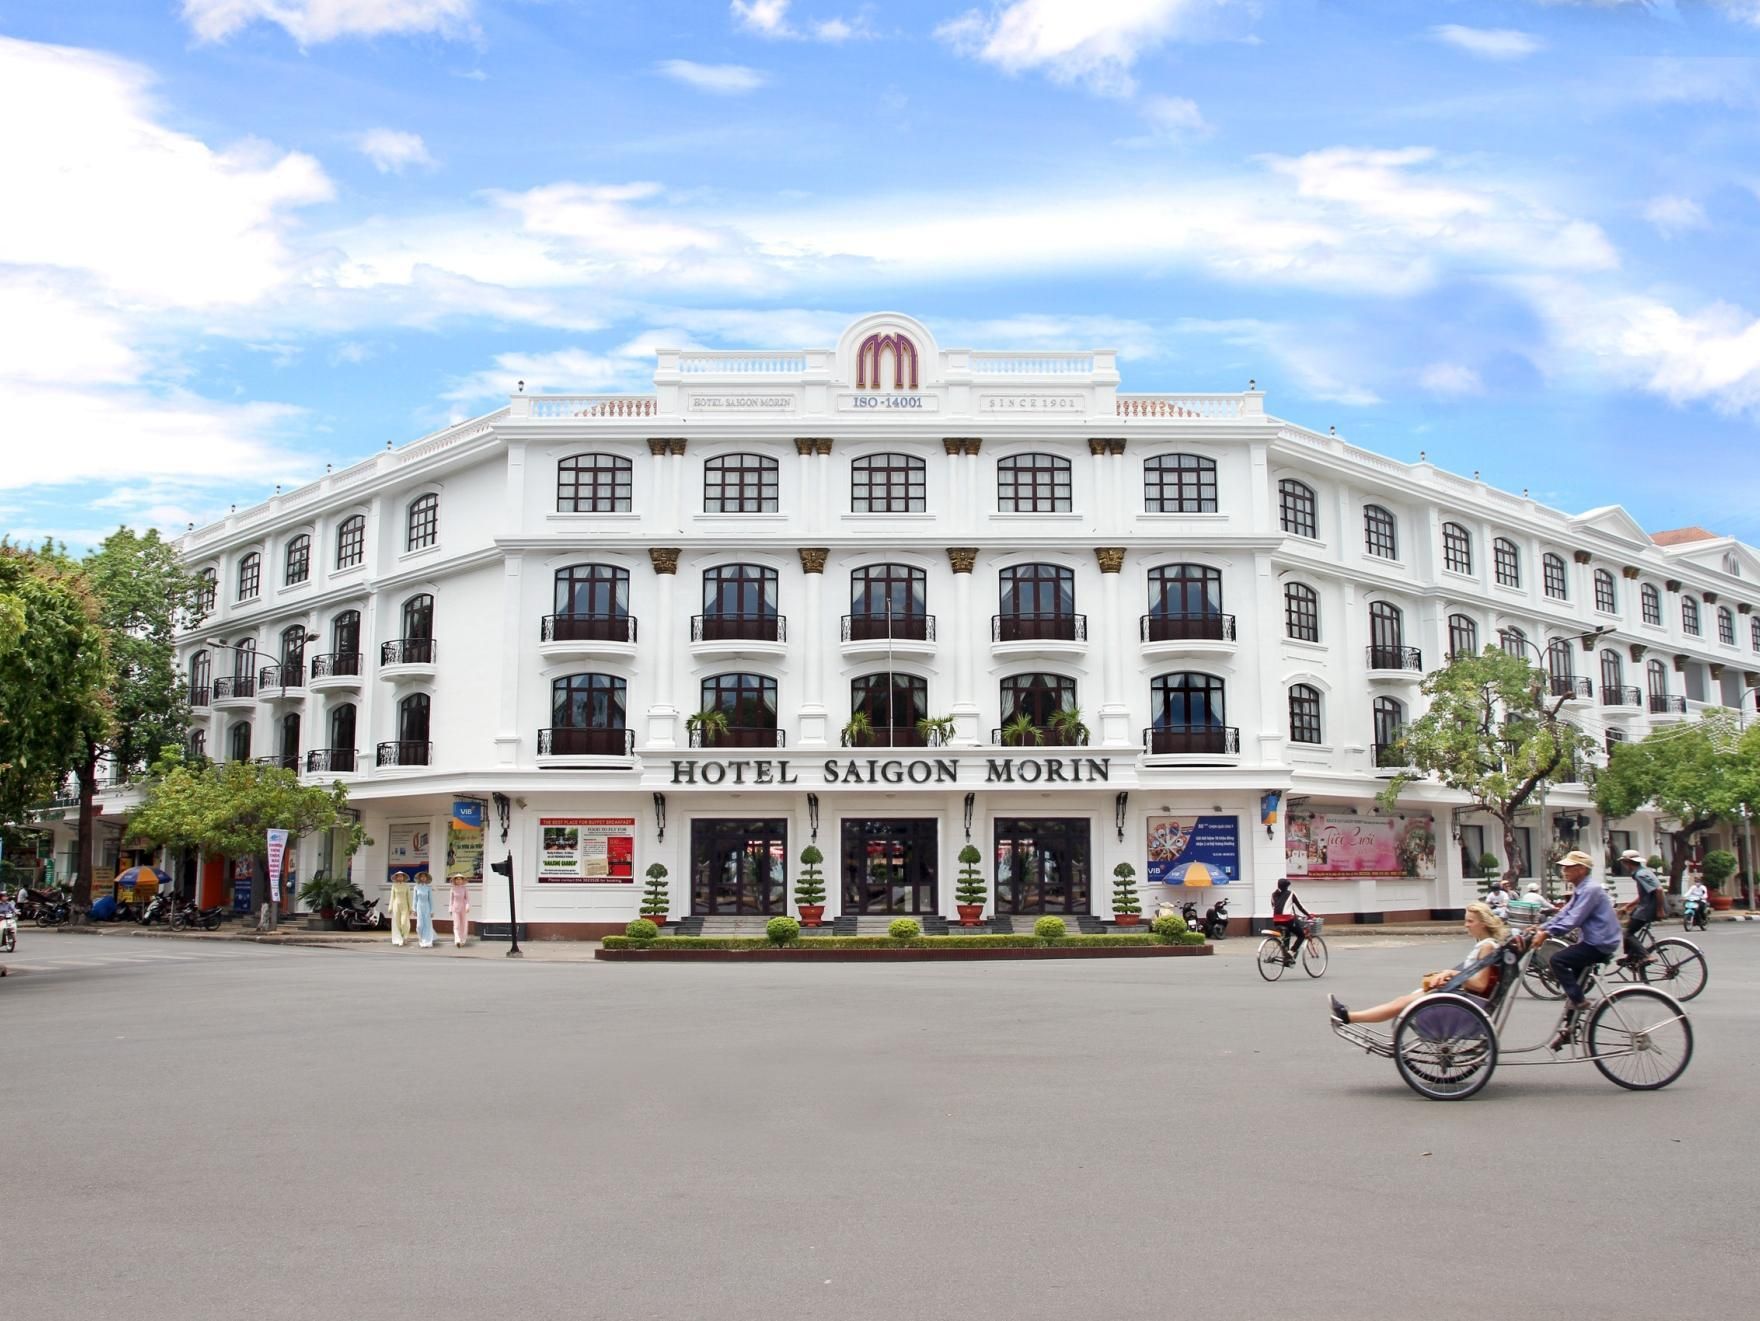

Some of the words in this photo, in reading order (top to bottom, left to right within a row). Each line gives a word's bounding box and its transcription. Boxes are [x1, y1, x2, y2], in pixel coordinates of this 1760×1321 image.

[693, 398, 724, 407] HOTEL
[725, 398, 758, 407] SAIGON
[759, 398, 791, 407] MORIN
[989, 398, 1037, 408] SINCE
[670, 760, 798, 784] HOTEL
[823, 759, 959, 784] SAIGON
[985, 758, 1110, 783] MORIN
